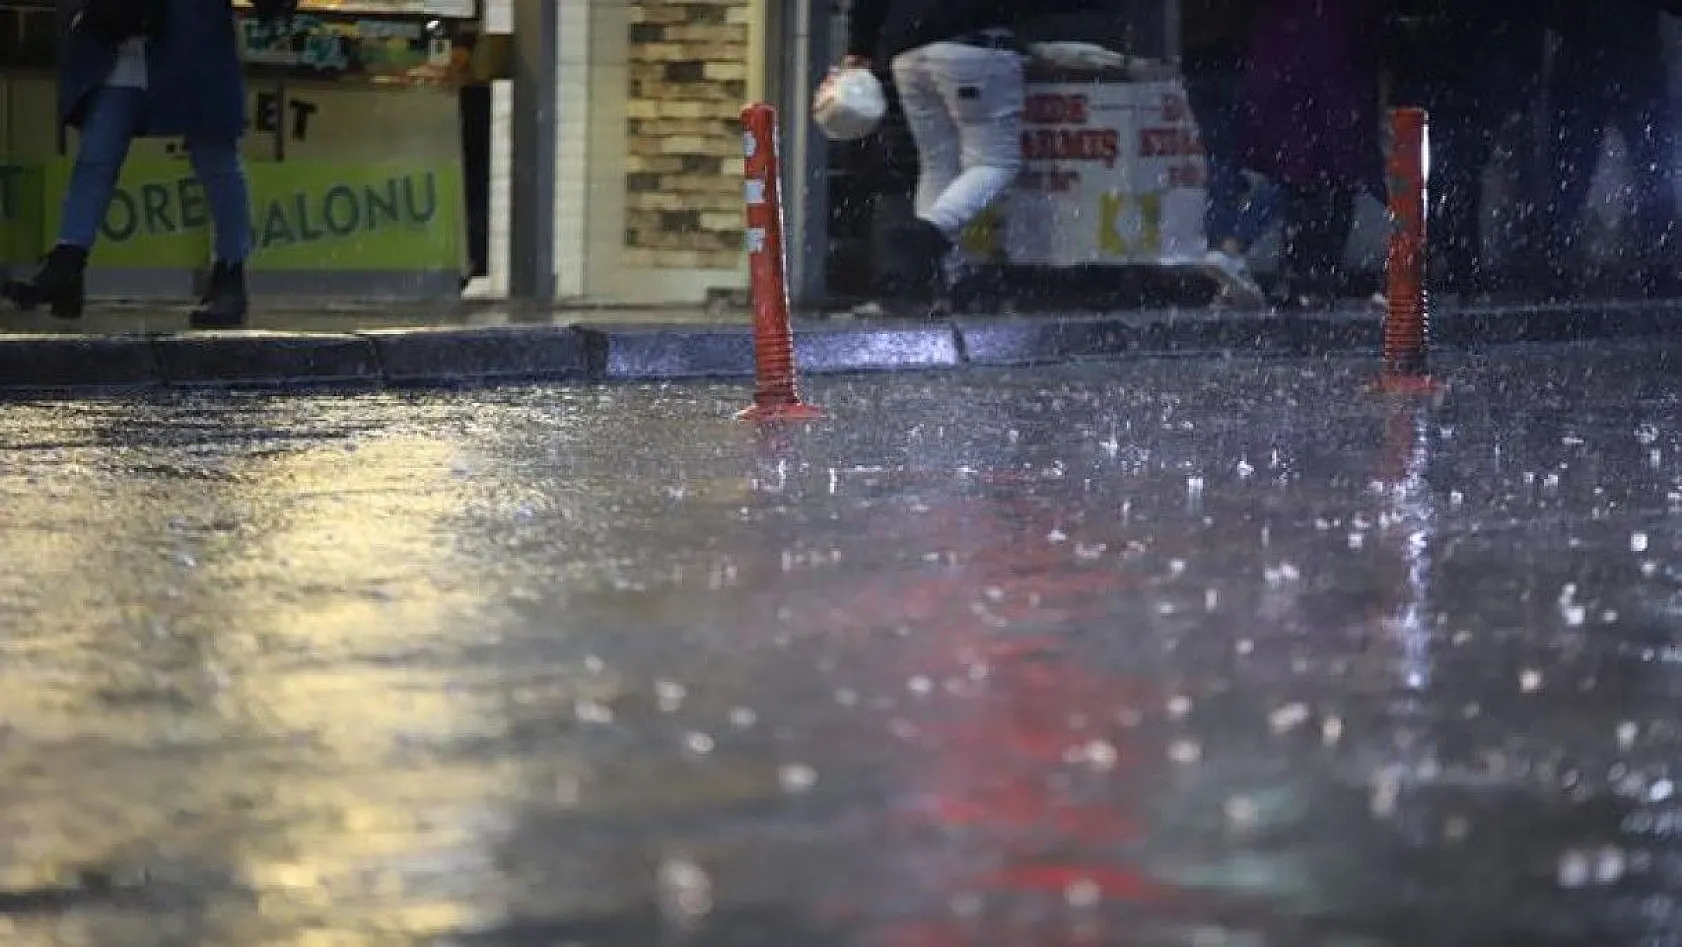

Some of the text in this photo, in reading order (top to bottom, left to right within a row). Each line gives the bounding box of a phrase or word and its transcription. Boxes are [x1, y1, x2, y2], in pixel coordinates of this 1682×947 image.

[1020, 129, 1119, 168] ARMIŞ
[101, 172, 437, 248] ORE ALONU
